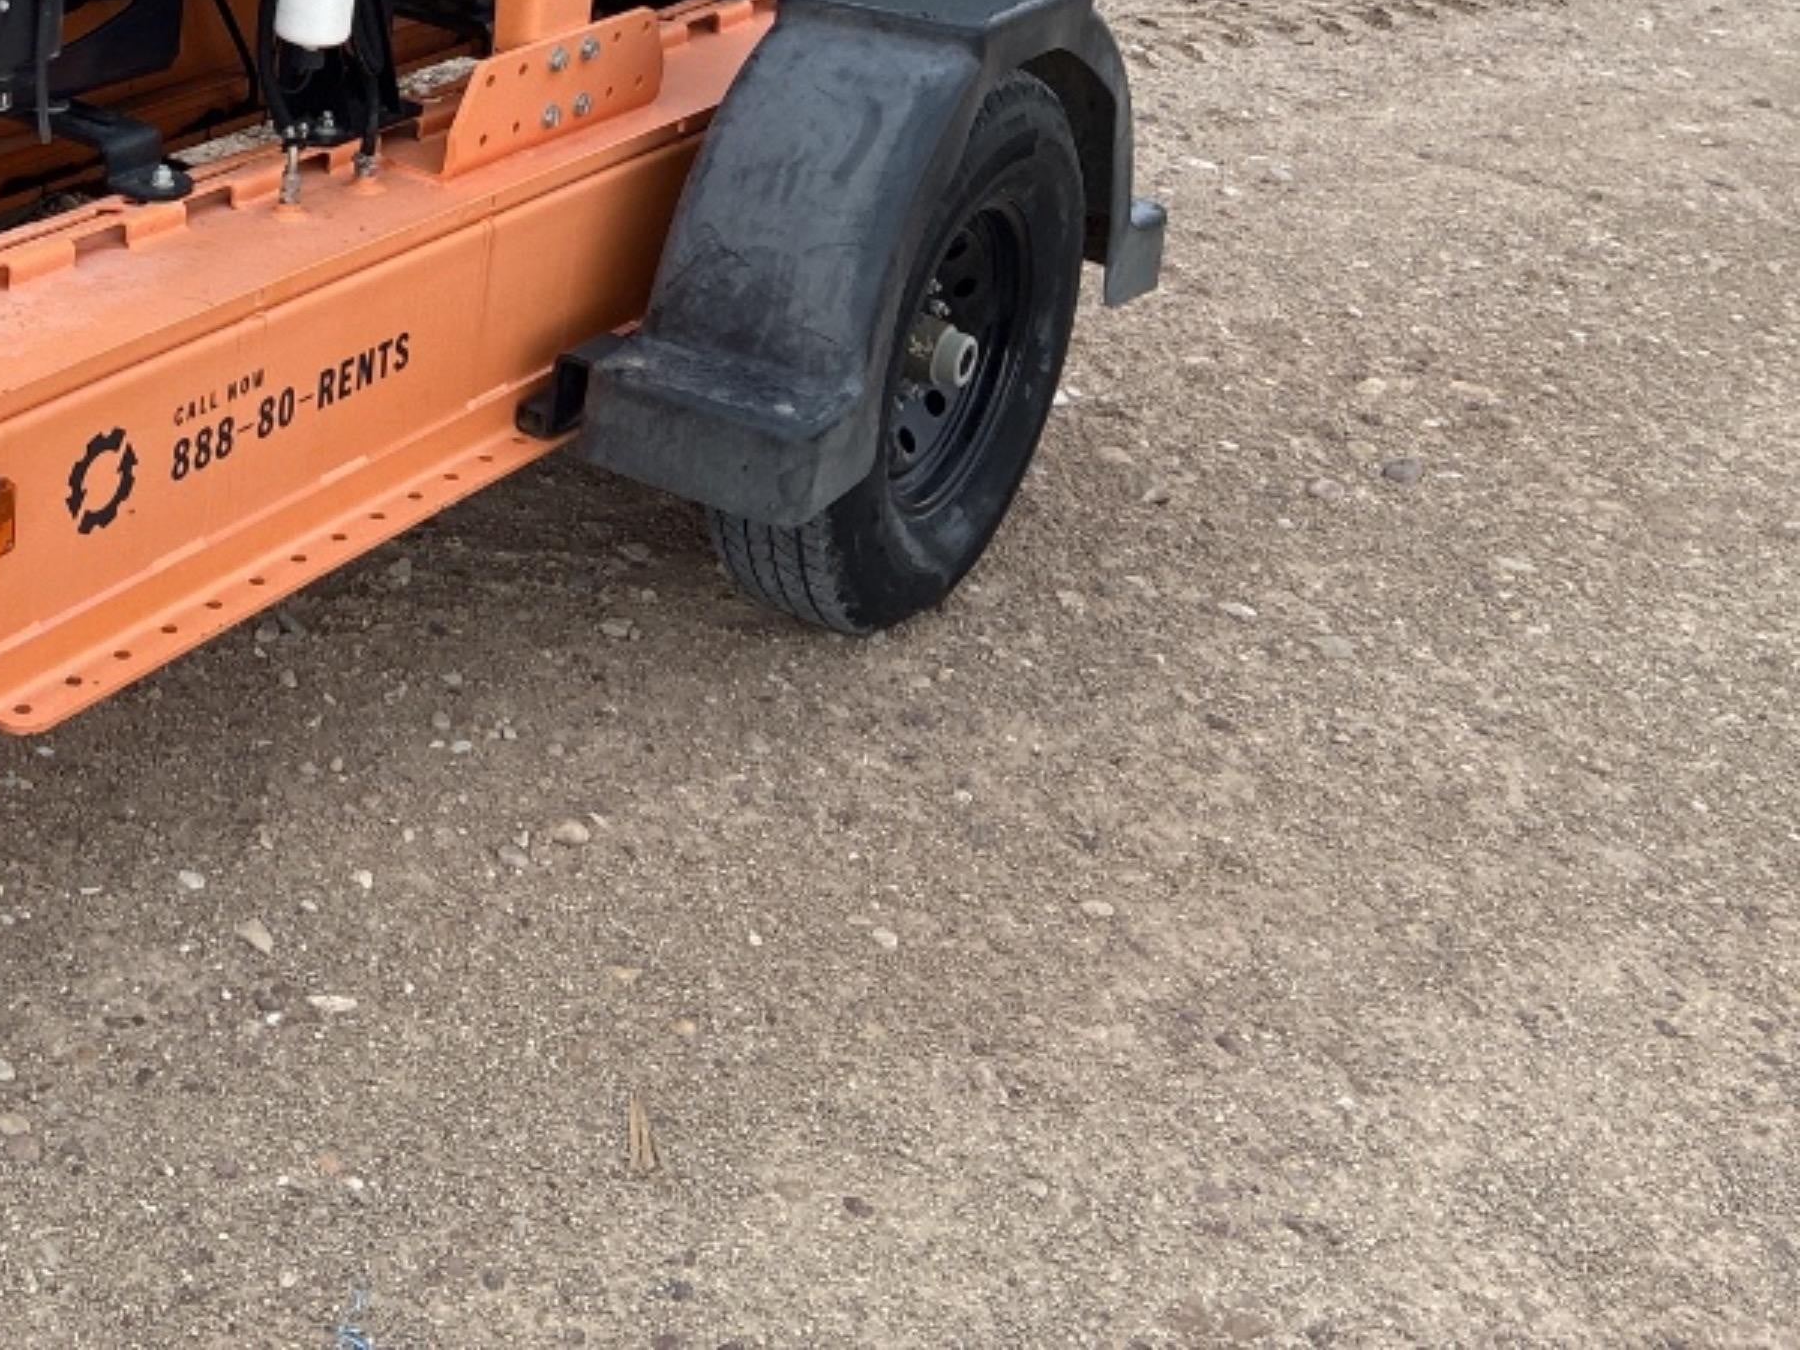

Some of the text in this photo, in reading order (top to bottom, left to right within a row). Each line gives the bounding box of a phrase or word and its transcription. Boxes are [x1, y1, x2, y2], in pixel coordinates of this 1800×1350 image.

[171, 332, 410, 481] 888-80-RENTS
[173, 369, 264, 427] CALL NOW
